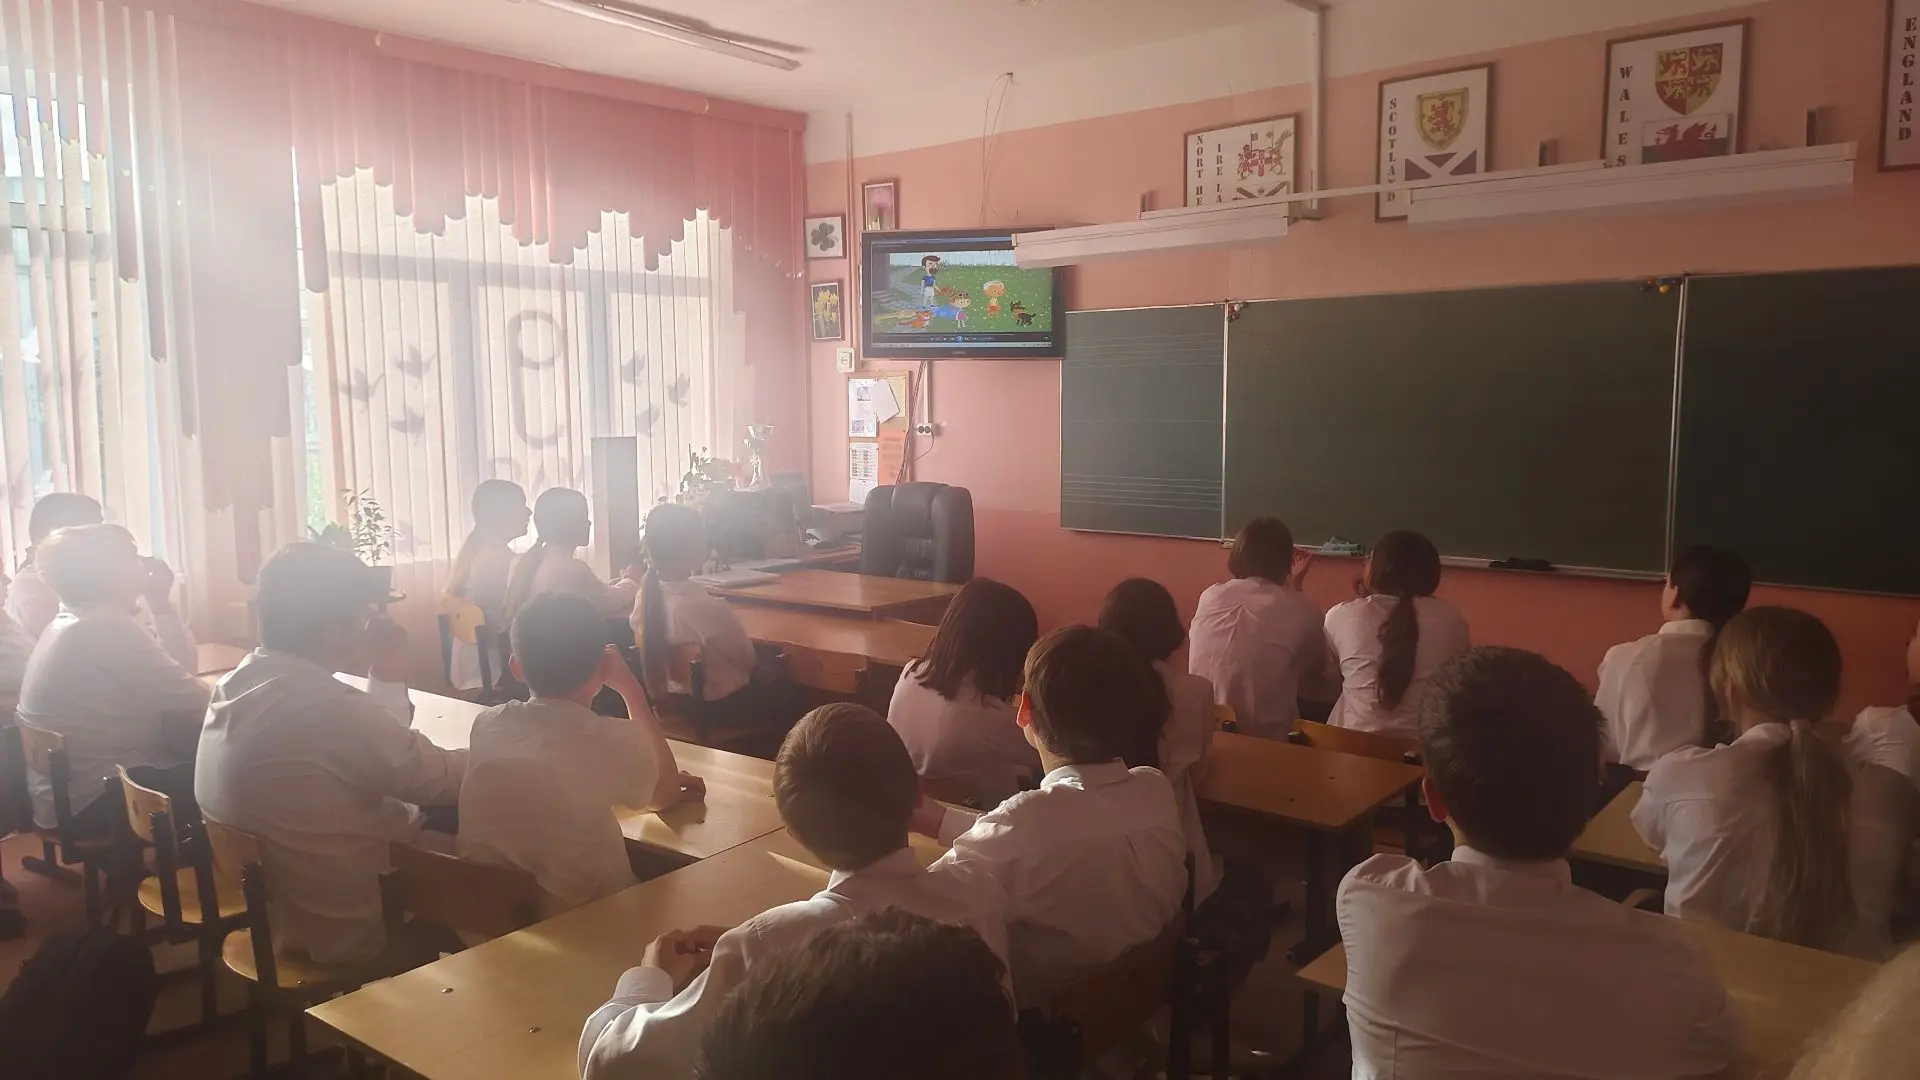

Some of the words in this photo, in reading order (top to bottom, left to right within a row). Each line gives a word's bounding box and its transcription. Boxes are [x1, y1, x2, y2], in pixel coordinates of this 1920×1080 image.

[1616, 66, 1632, 167] WALES
[1897, 16, 1917, 141] ENGLAND
[1196, 135, 1204, 206] NORTHE
